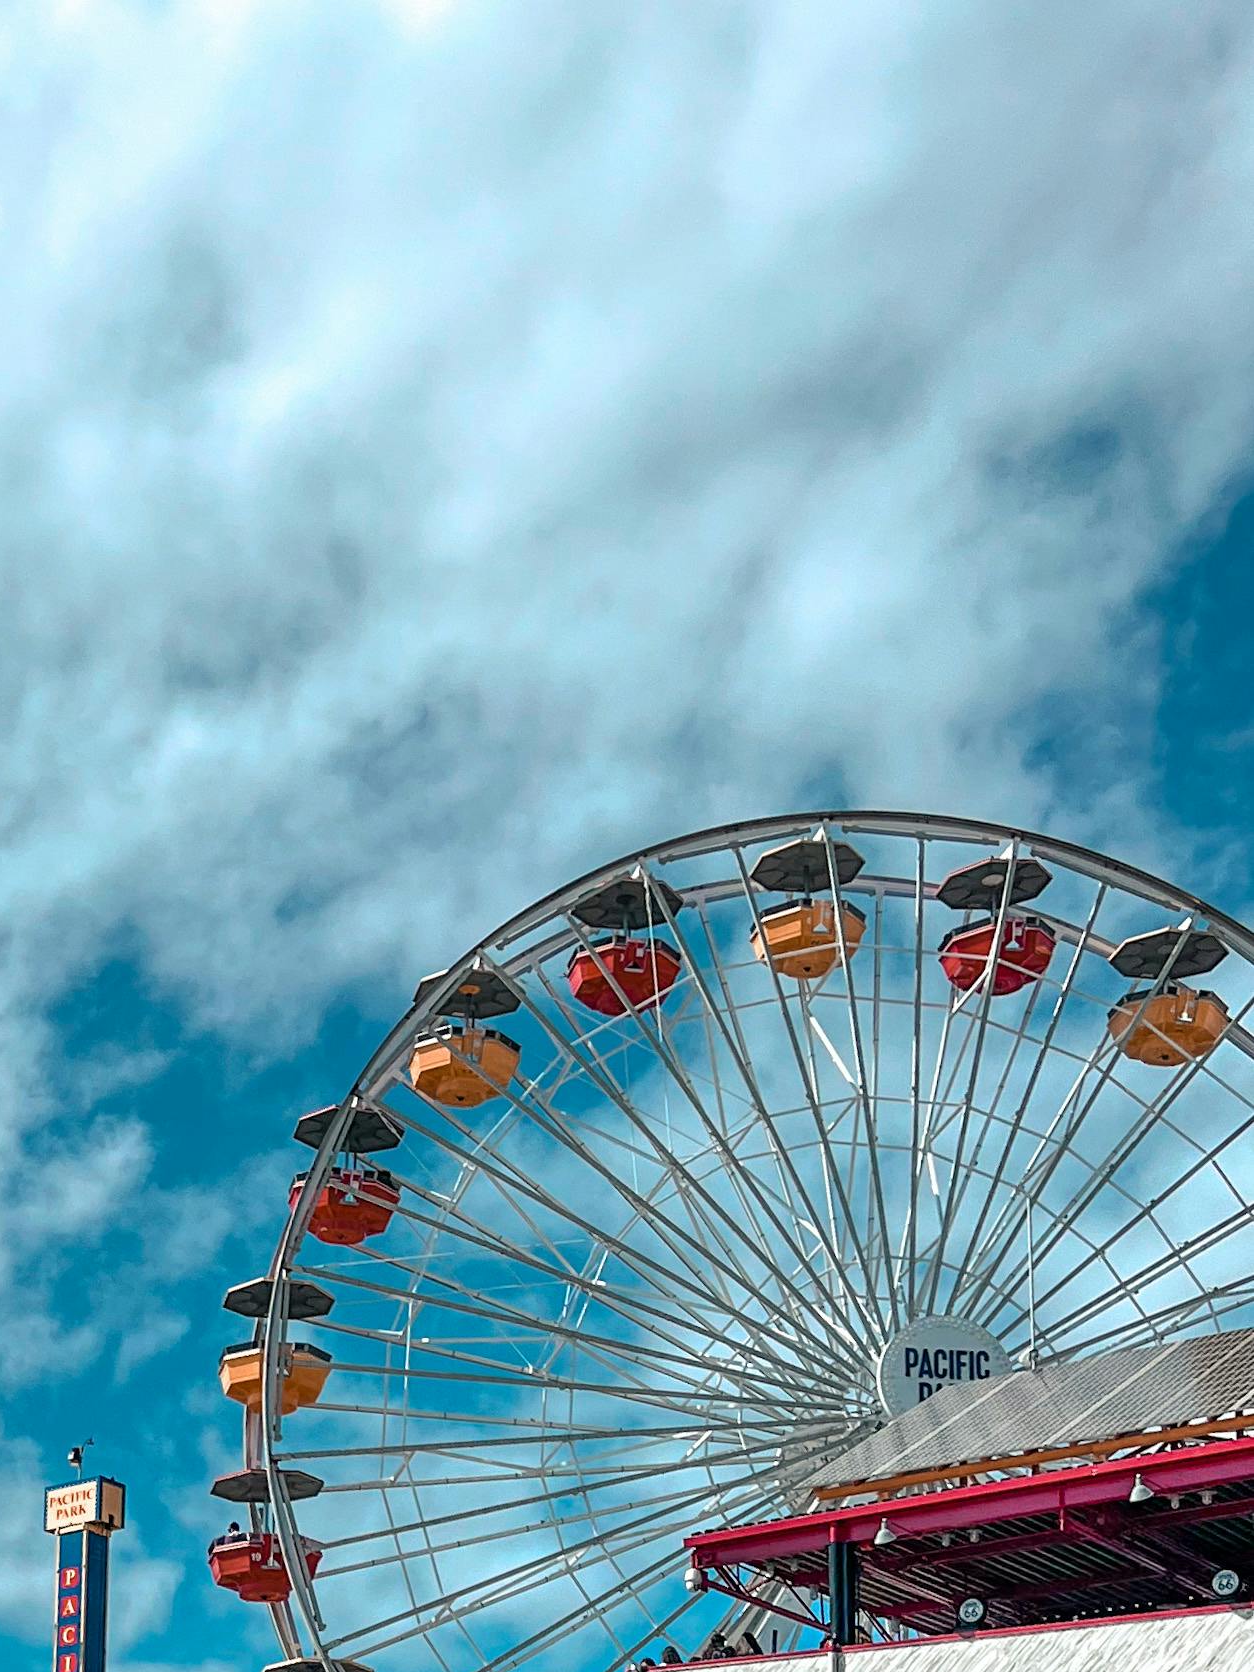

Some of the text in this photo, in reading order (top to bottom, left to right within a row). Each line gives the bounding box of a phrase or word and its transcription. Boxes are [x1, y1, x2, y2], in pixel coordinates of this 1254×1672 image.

[905, 1347, 991, 1381] PACIFIC
[49, 1488, 94, 1508] PACIFIC
[56, 1505, 86, 1520] PARK
[1218, 1579, 1233, 1590] 66
